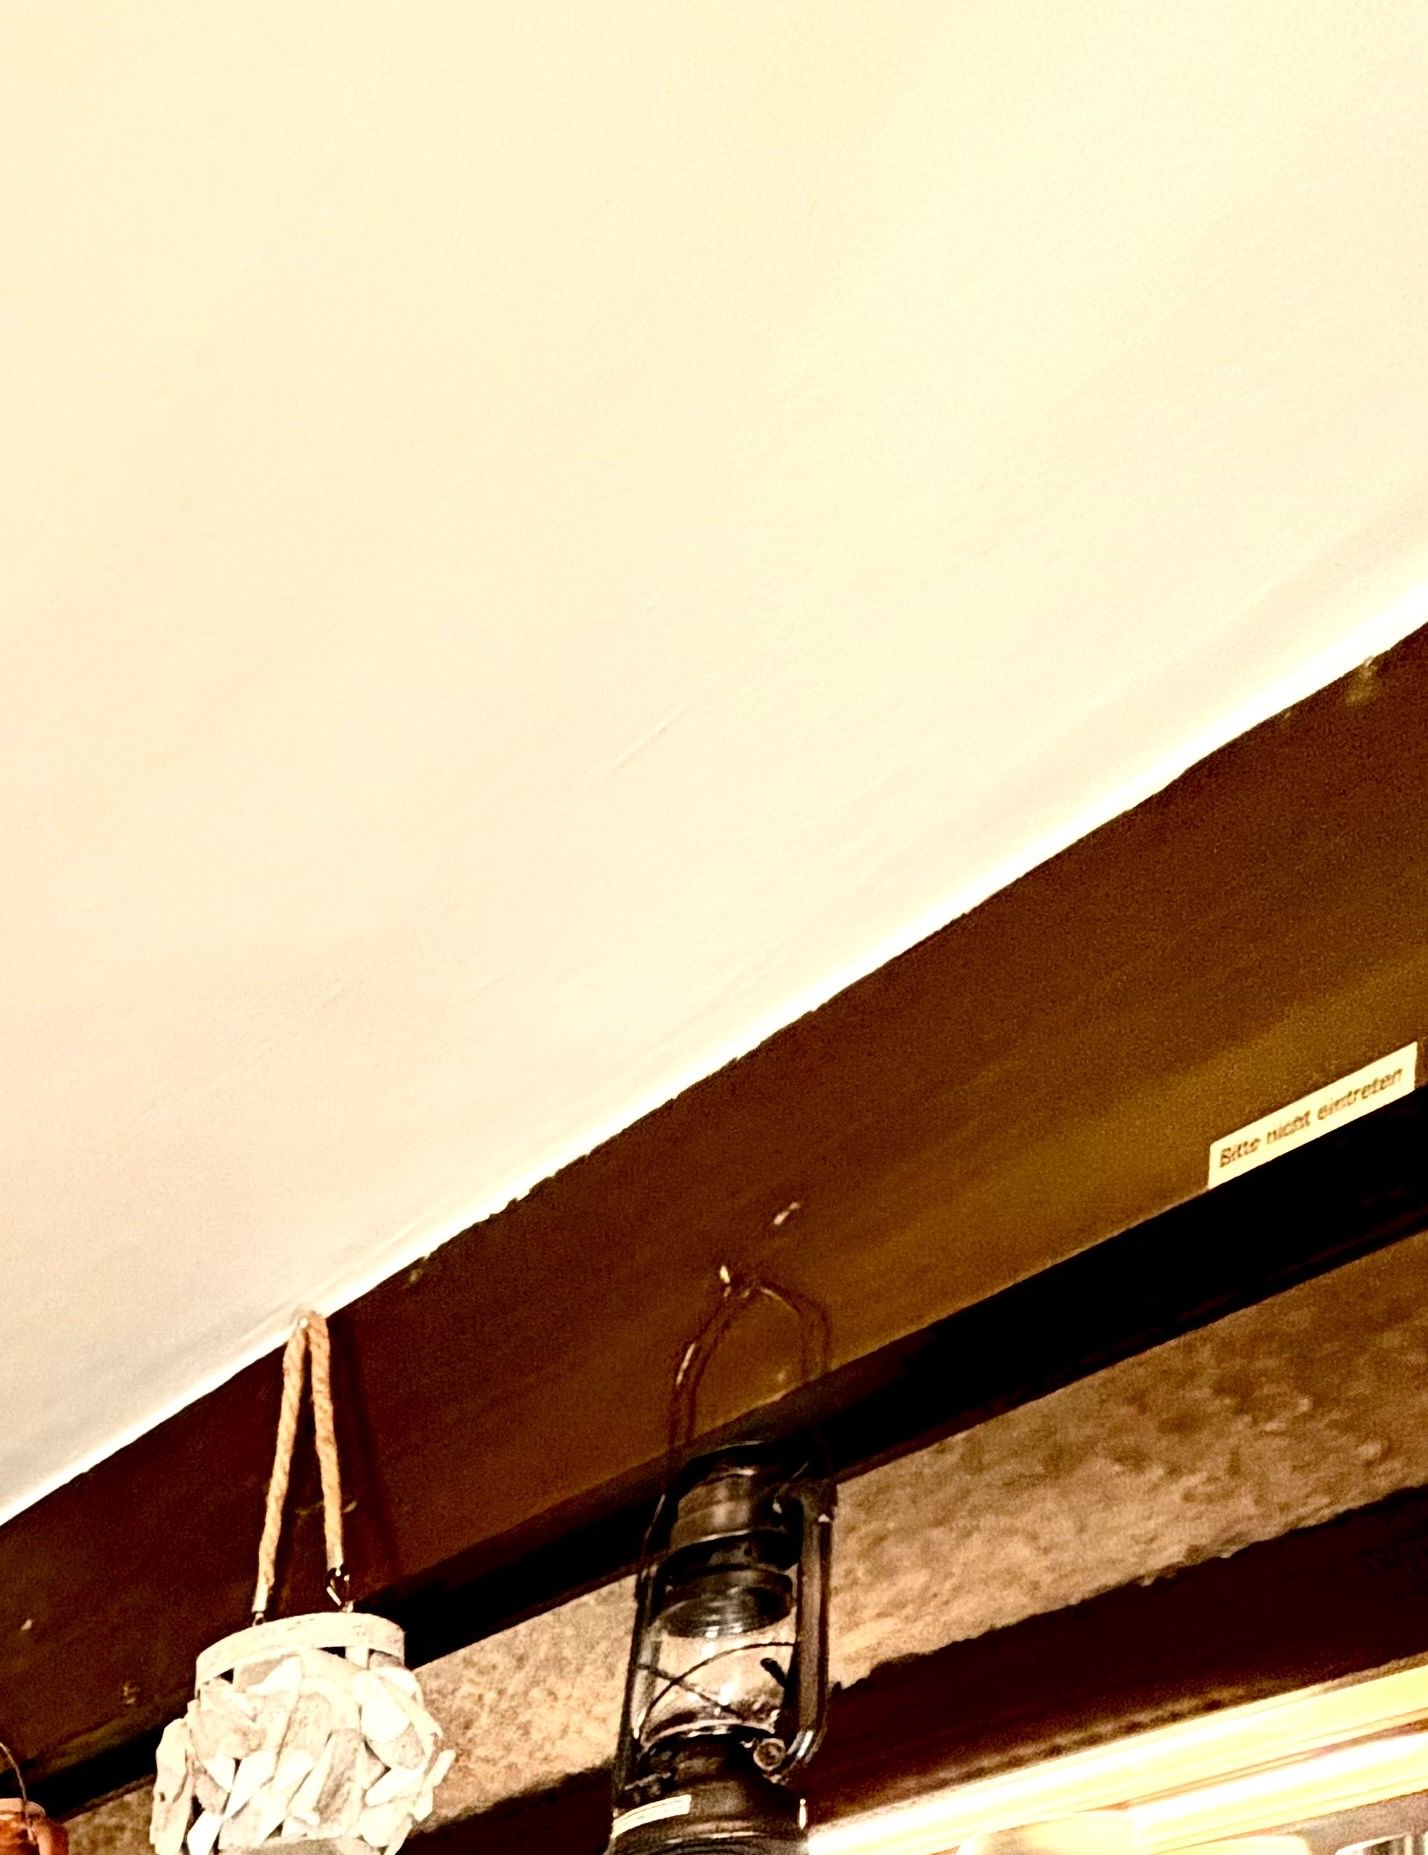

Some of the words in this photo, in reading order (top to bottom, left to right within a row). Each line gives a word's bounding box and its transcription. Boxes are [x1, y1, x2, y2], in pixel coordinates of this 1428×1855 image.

[1219, 1138, 1260, 1168] Bitte
[1266, 1110, 1311, 1146] nicht
[1317, 1068, 1403, 1121] eintreten
